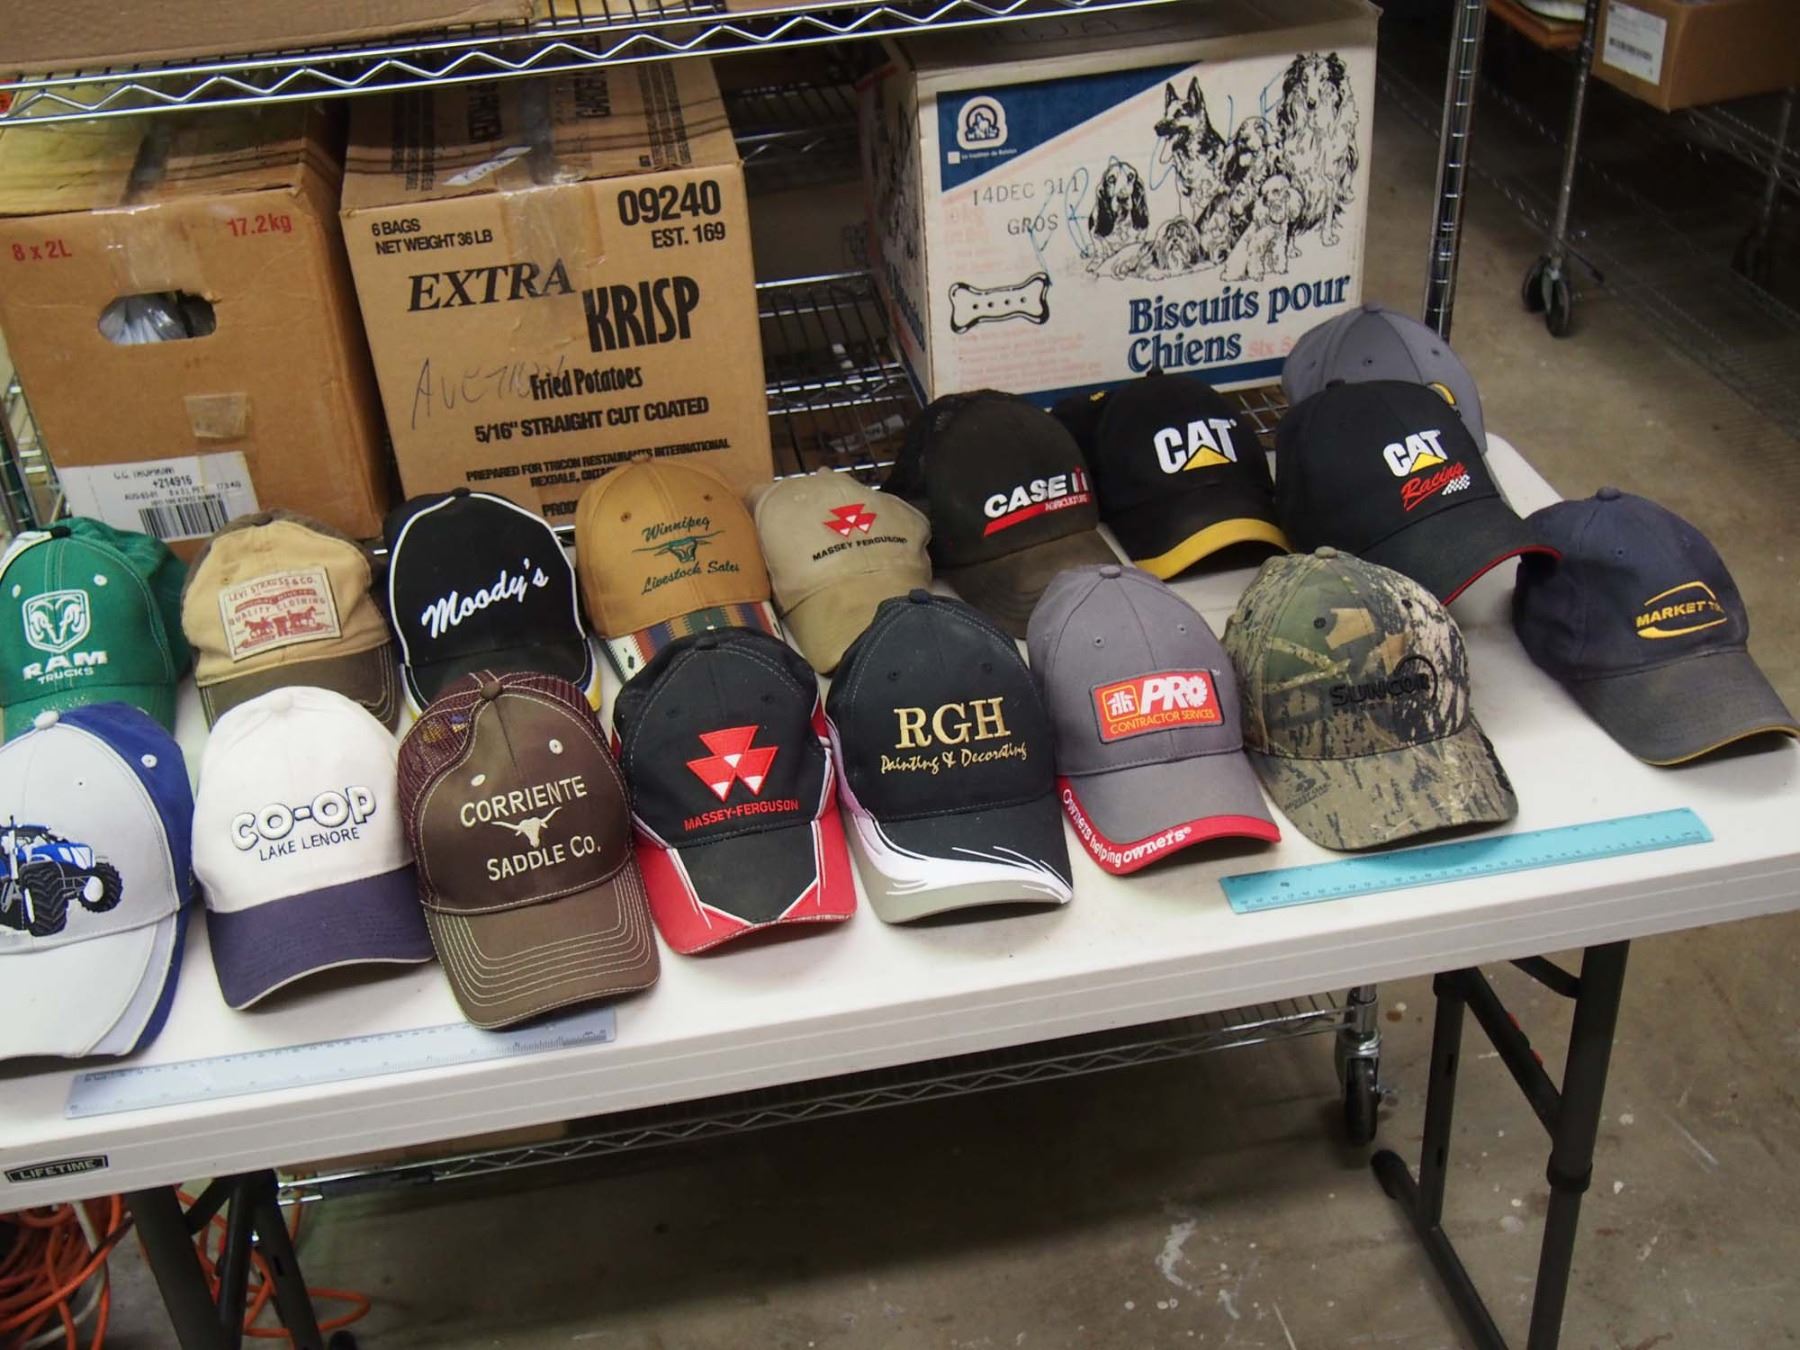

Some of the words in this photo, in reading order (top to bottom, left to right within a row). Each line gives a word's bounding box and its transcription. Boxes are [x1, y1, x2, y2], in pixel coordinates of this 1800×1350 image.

[616, 179, 722, 227] 09240
[227, 213, 292, 238] 17.2kg
[371, 222, 380, 237] 6
[381, 218, 421, 236] BAGS
[375, 239, 402, 255] NET
[404, 233, 456, 251] WEIGHT
[457, 231, 474, 246] 36
[475, 228, 493, 245] LB
[651, 227, 689, 249] EST.
[693, 221, 726, 243] 169
[1007, 213, 1059, 236] GROS
[12, 243, 25, 261] 8
[45, 239, 72, 260] 2L
[407, 257, 576, 313] EXTRA
[582, 275, 700, 353] KRISP
[1128, 285, 1260, 336] Biscuits
[1267, 274, 1351, 325] pour
[1127, 332, 1242, 374] Chiens
[530, 368, 572, 401] Fried
[573, 366, 643, 395] Potatoes
[474, 420, 518, 444] 5/16"
[520, 410, 604, 437] STRAIGHT
[607, 405, 641, 426] CUT
[644, 396, 710, 422] COATED
[466, 466, 520, 482] PREPARED
[521, 463, 543, 476] FOR
[653, 438, 731, 458] INTERNATIONAL
[1152, 418, 1238, 475] CAT
[1382, 429, 1450, 477] CAT
[983, 474, 1068, 520] CASE
[1400, 461, 1468, 509] Racing
[641, 515, 711, 544] Winnipeg
[812, 540, 853, 562] MASSEY
[855, 534, 908, 549] FERGUSON
[228, 590, 248, 602] LEVI
[250, 577, 291, 594] STRAUSS
[641, 561, 701, 596] Livestock
[707, 560, 740, 576] Sales
[228, 605, 271, 626] QUALITY
[276, 596, 327, 612] CLOTHING
[421, 557, 550, 640] Moody's
[1635, 600, 1706, 628] MARKET
[23, 650, 108, 680] RAM
[38, 666, 95, 685] TRUCKS
[1140, 675, 1208, 715] PRO
[893, 697, 1012, 749] RGH
[1110, 711, 1181, 735] CONTRACTOR
[880, 754, 940, 775] Painting
[942, 751, 957, 769] &
[960, 742, 1027, 767] Decorating
[231, 785, 377, 852] CO-OP
[460, 775, 588, 828] CORRIENTE
[684, 799, 800, 832] MASSEY-FERGUSON
[258, 840, 297, 862] LAKE
[301, 826, 360, 851] LENORE
[1062, 788, 1092, 841] Owners
[1089, 834, 1122, 868] helping
[487, 843, 567, 881] SADDLE
[18, 1158, 96, 1180] LIFETIME
